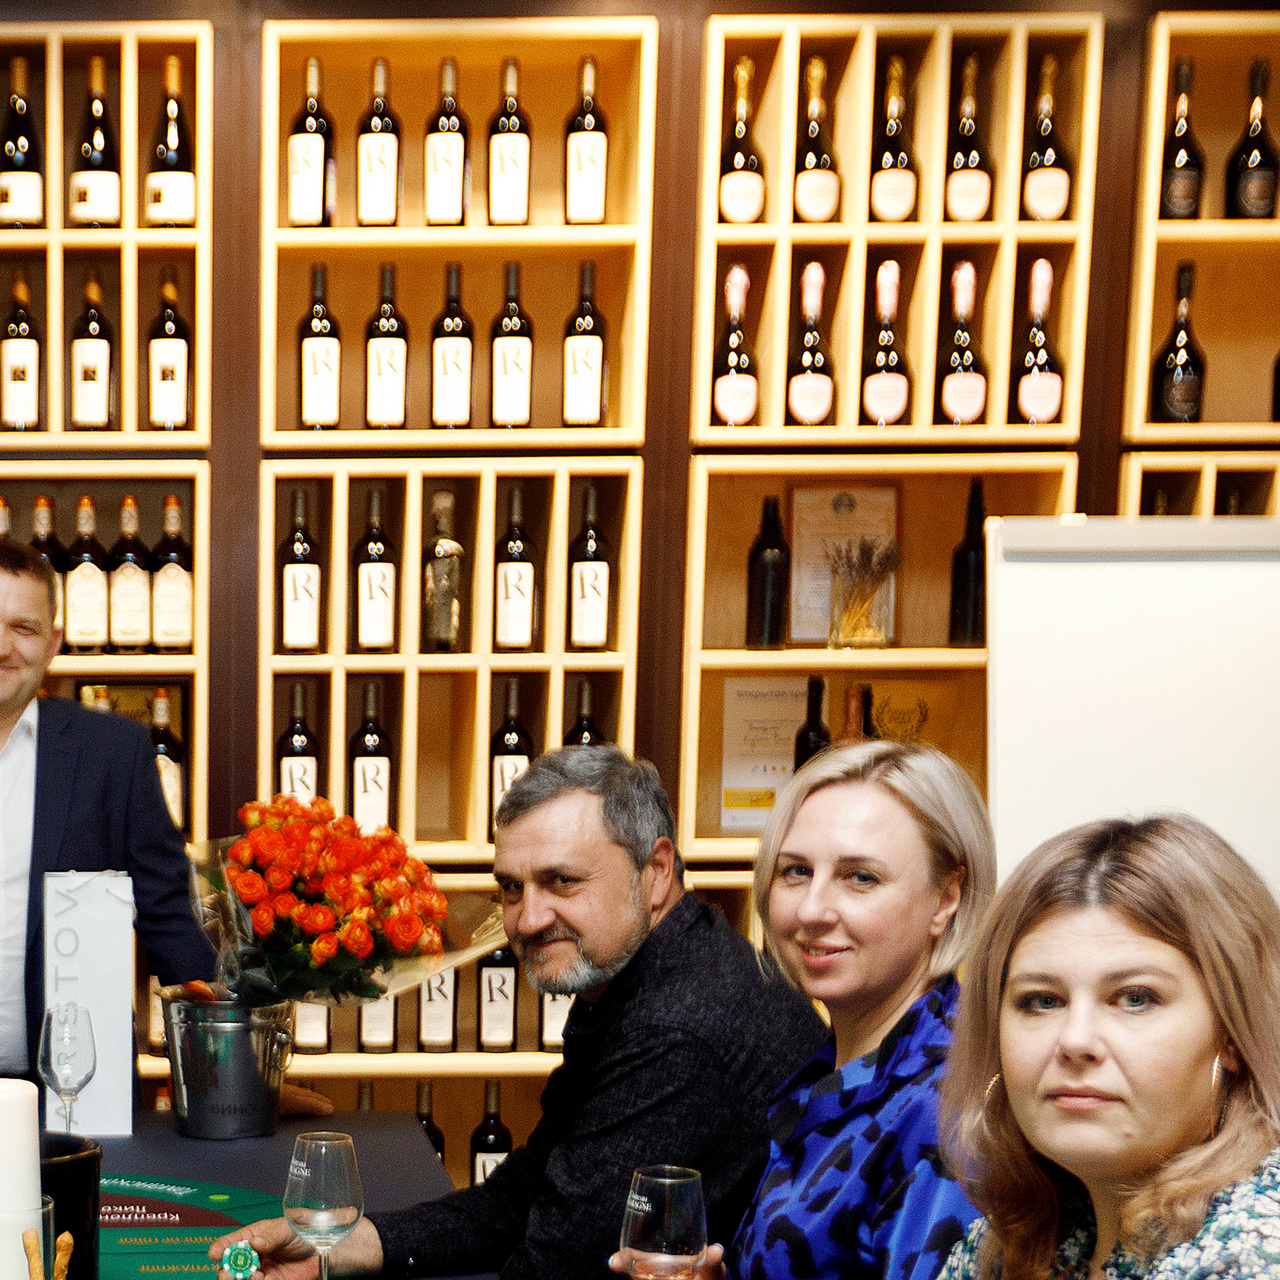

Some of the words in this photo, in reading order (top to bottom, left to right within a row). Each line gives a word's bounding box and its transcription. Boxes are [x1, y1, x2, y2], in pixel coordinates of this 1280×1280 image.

[291, 141, 313, 174] R
[366, 141, 389, 173] R
[431, 141, 454, 173] R
[497, 141, 520, 173] R
[577, 140, 598, 172] R
[311, 345, 333, 376] R
[376, 344, 398, 376] R
[441, 344, 464, 375] R
[502, 343, 524, 375] R
[571, 342, 594, 374] R
[292, 569, 314, 601] R
[366, 569, 389, 600] R
[503, 568, 525, 600] R
[579, 568, 601, 599] R
[288, 763, 311, 794] R
[360, 762, 383, 793] R
[426, 973, 449, 1002] R
[488, 973, 510, 1002] R
